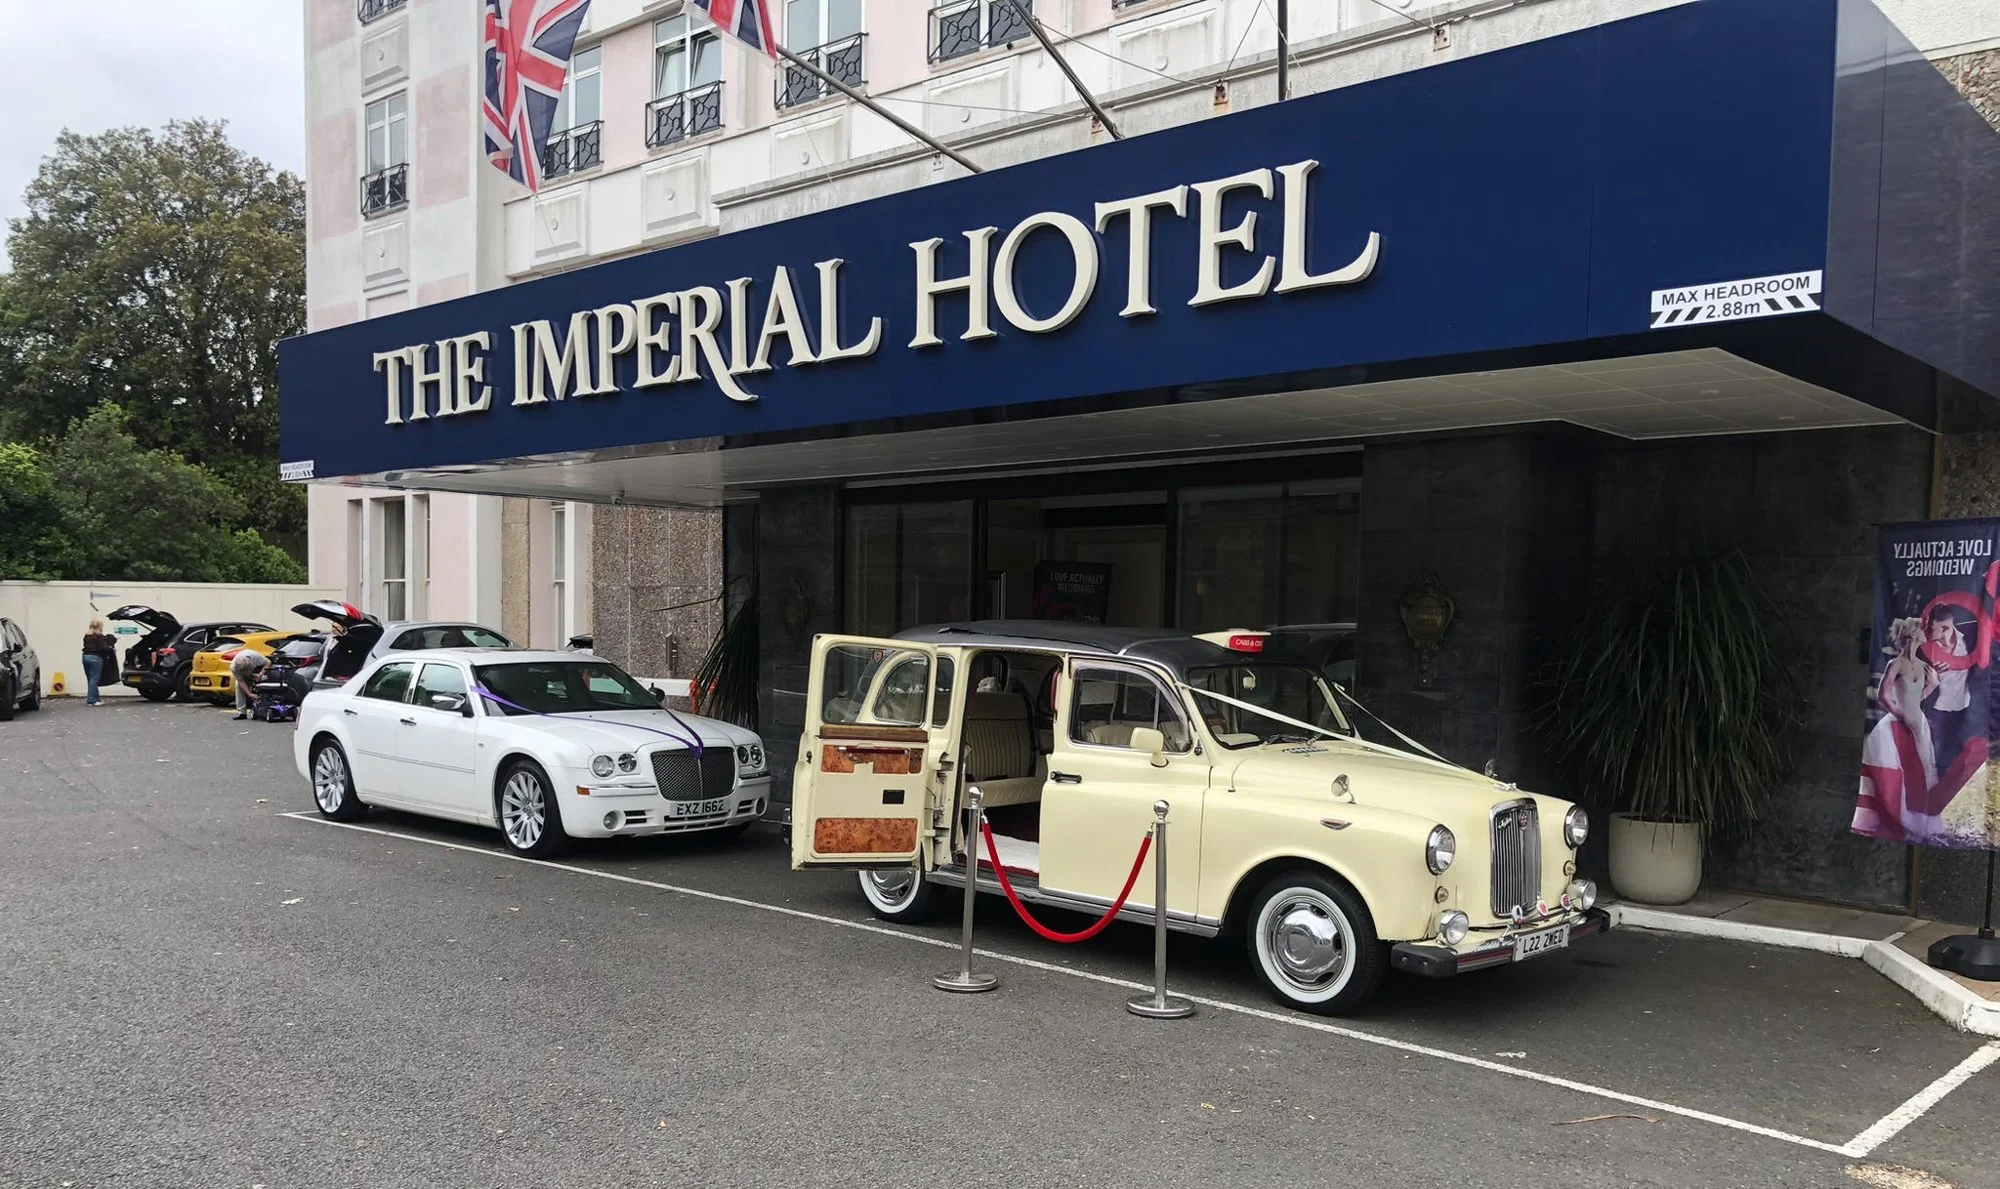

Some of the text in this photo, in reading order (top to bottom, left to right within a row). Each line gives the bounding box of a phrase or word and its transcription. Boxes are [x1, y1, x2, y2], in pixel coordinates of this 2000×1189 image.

[373, 158, 1380, 425] THE IMPERIAL HOTEL
[1661, 275, 1810, 306] MAX HEADROOM
[1705, 300, 1760, 319] 2.88m
[676, 799, 724, 815] EXZ 1662
[1523, 935, 1540, 953] L22
